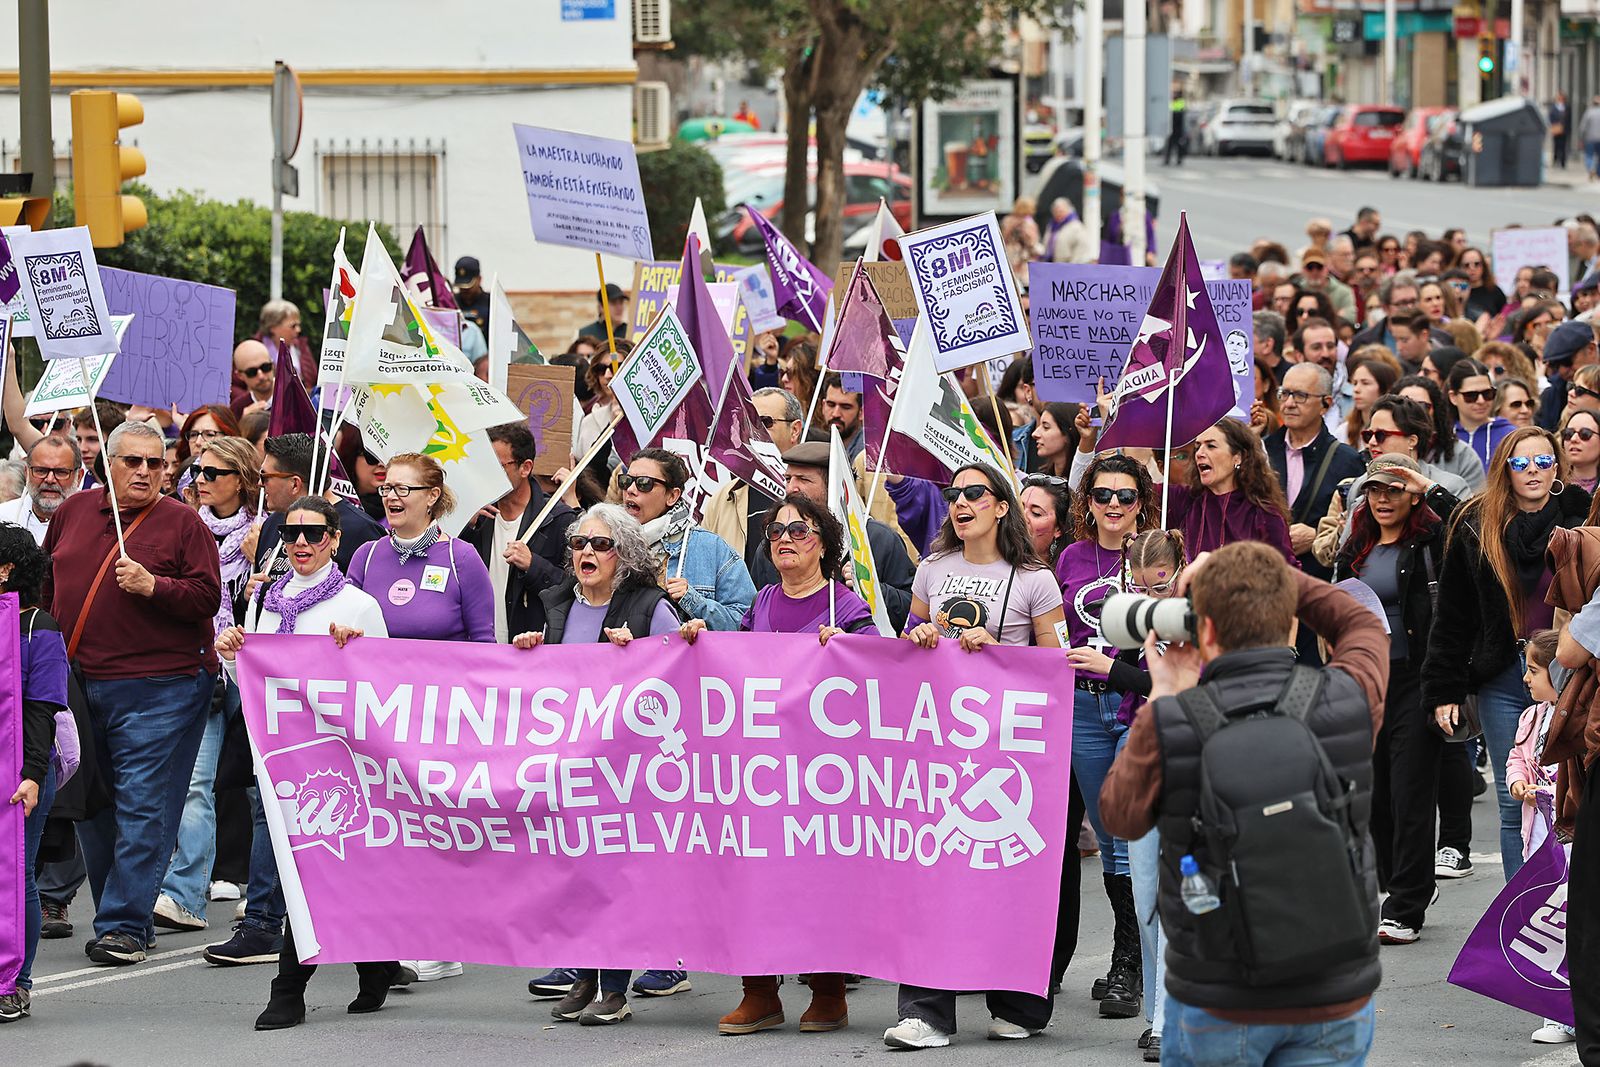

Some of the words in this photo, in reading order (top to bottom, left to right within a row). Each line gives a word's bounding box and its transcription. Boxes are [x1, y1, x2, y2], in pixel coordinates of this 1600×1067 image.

[526, 144, 539, 158] LA
[538, 146, 580, 164] MAESTRA
[563, 175, 585, 193] ESTÁ
[931, 247, 972, 278] 8M
[39, 266, 67, 286] 8M
[941, 262, 996, 291] FEMINISMO
[943, 273, 994, 300] FASCISMO
[37, 283, 72, 296] Feminismo
[39, 294, 56, 306] para
[55, 288, 88, 302] cambiarlo
[72, 295, 89, 305] todo
[1051, 280, 1137, 303] MARCHAR
[1207, 282, 1249, 301] UINAN
[1036, 307, 1087, 321] AUNQUE
[1094, 310, 1113, 321] NO
[1118, 311, 1137, 322] TE
[1038, 324, 1080, 340] FALTE
[1088, 326, 1132, 341] NADA
[658, 338, 683, 373] 8M
[1039, 344, 1100, 362] PORQUE
[1110, 348, 1122, 362] A
[378, 363, 452, 373] convocatoria
[645, 350, 676, 395] ANDALUZAS
[1042, 365, 1071, 379] LES
[923, 433, 963, 466] convocat
[925, 421, 971, 457] izquierda
[937, 572, 1008, 602] ¡BASTA!
[264, 676, 682, 747] FEMINISMO
[700, 676, 782, 739] DE
[808, 676, 1049, 754] CLASE
[354, 751, 501, 809] PARA
[365, 807, 516, 853] DESDE
[523, 812, 712, 858] HUELVA
[718, 814, 768, 858] AL
[783, 814, 943, 867] MUNDO
[942, 829, 1031, 870] PCE
